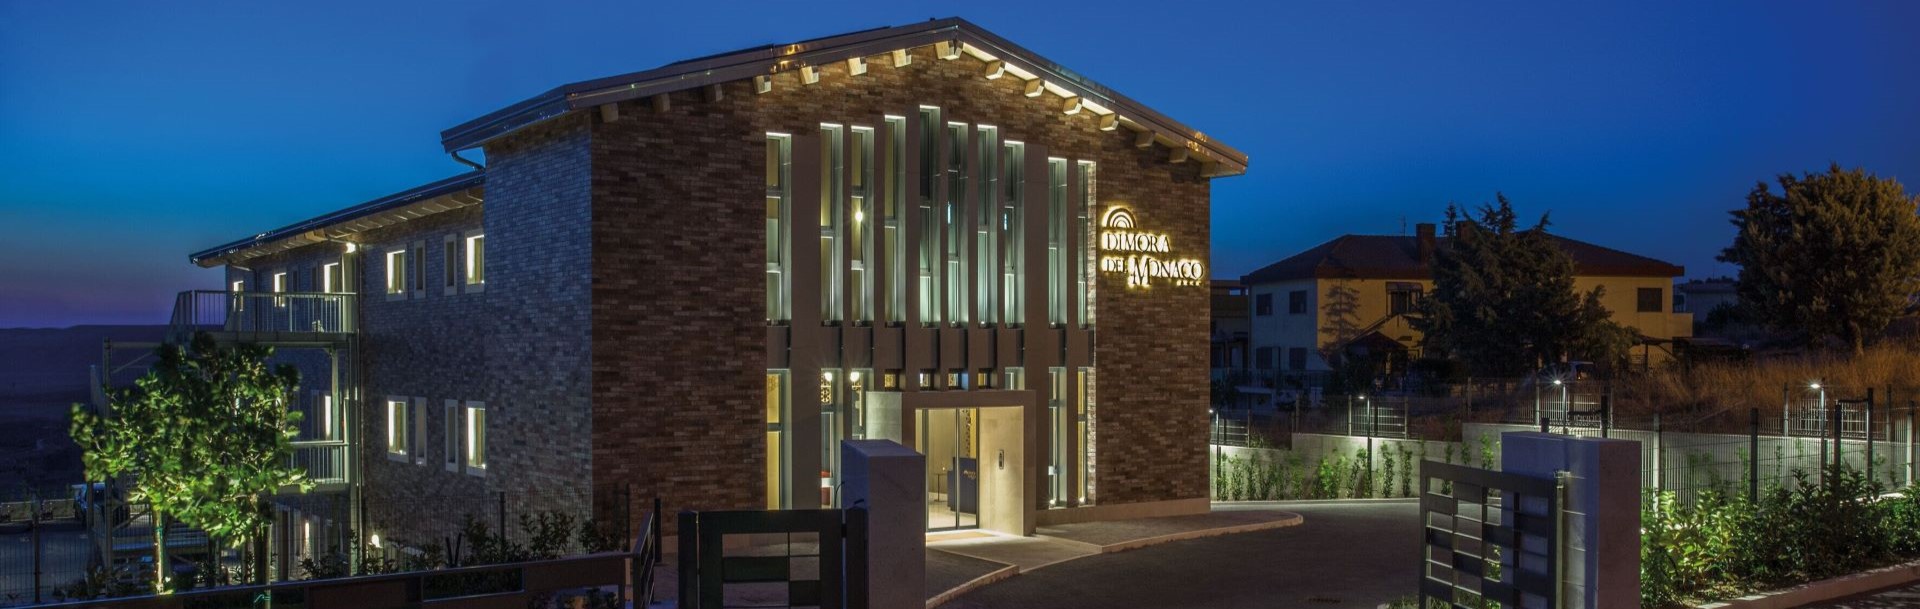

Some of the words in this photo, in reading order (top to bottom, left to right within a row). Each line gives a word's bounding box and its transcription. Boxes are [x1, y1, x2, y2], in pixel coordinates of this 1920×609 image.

[1105, 232, 1171, 252] DIMORA
[1105, 259, 1128, 274] DEL
[1131, 257, 1204, 285] MONACO
